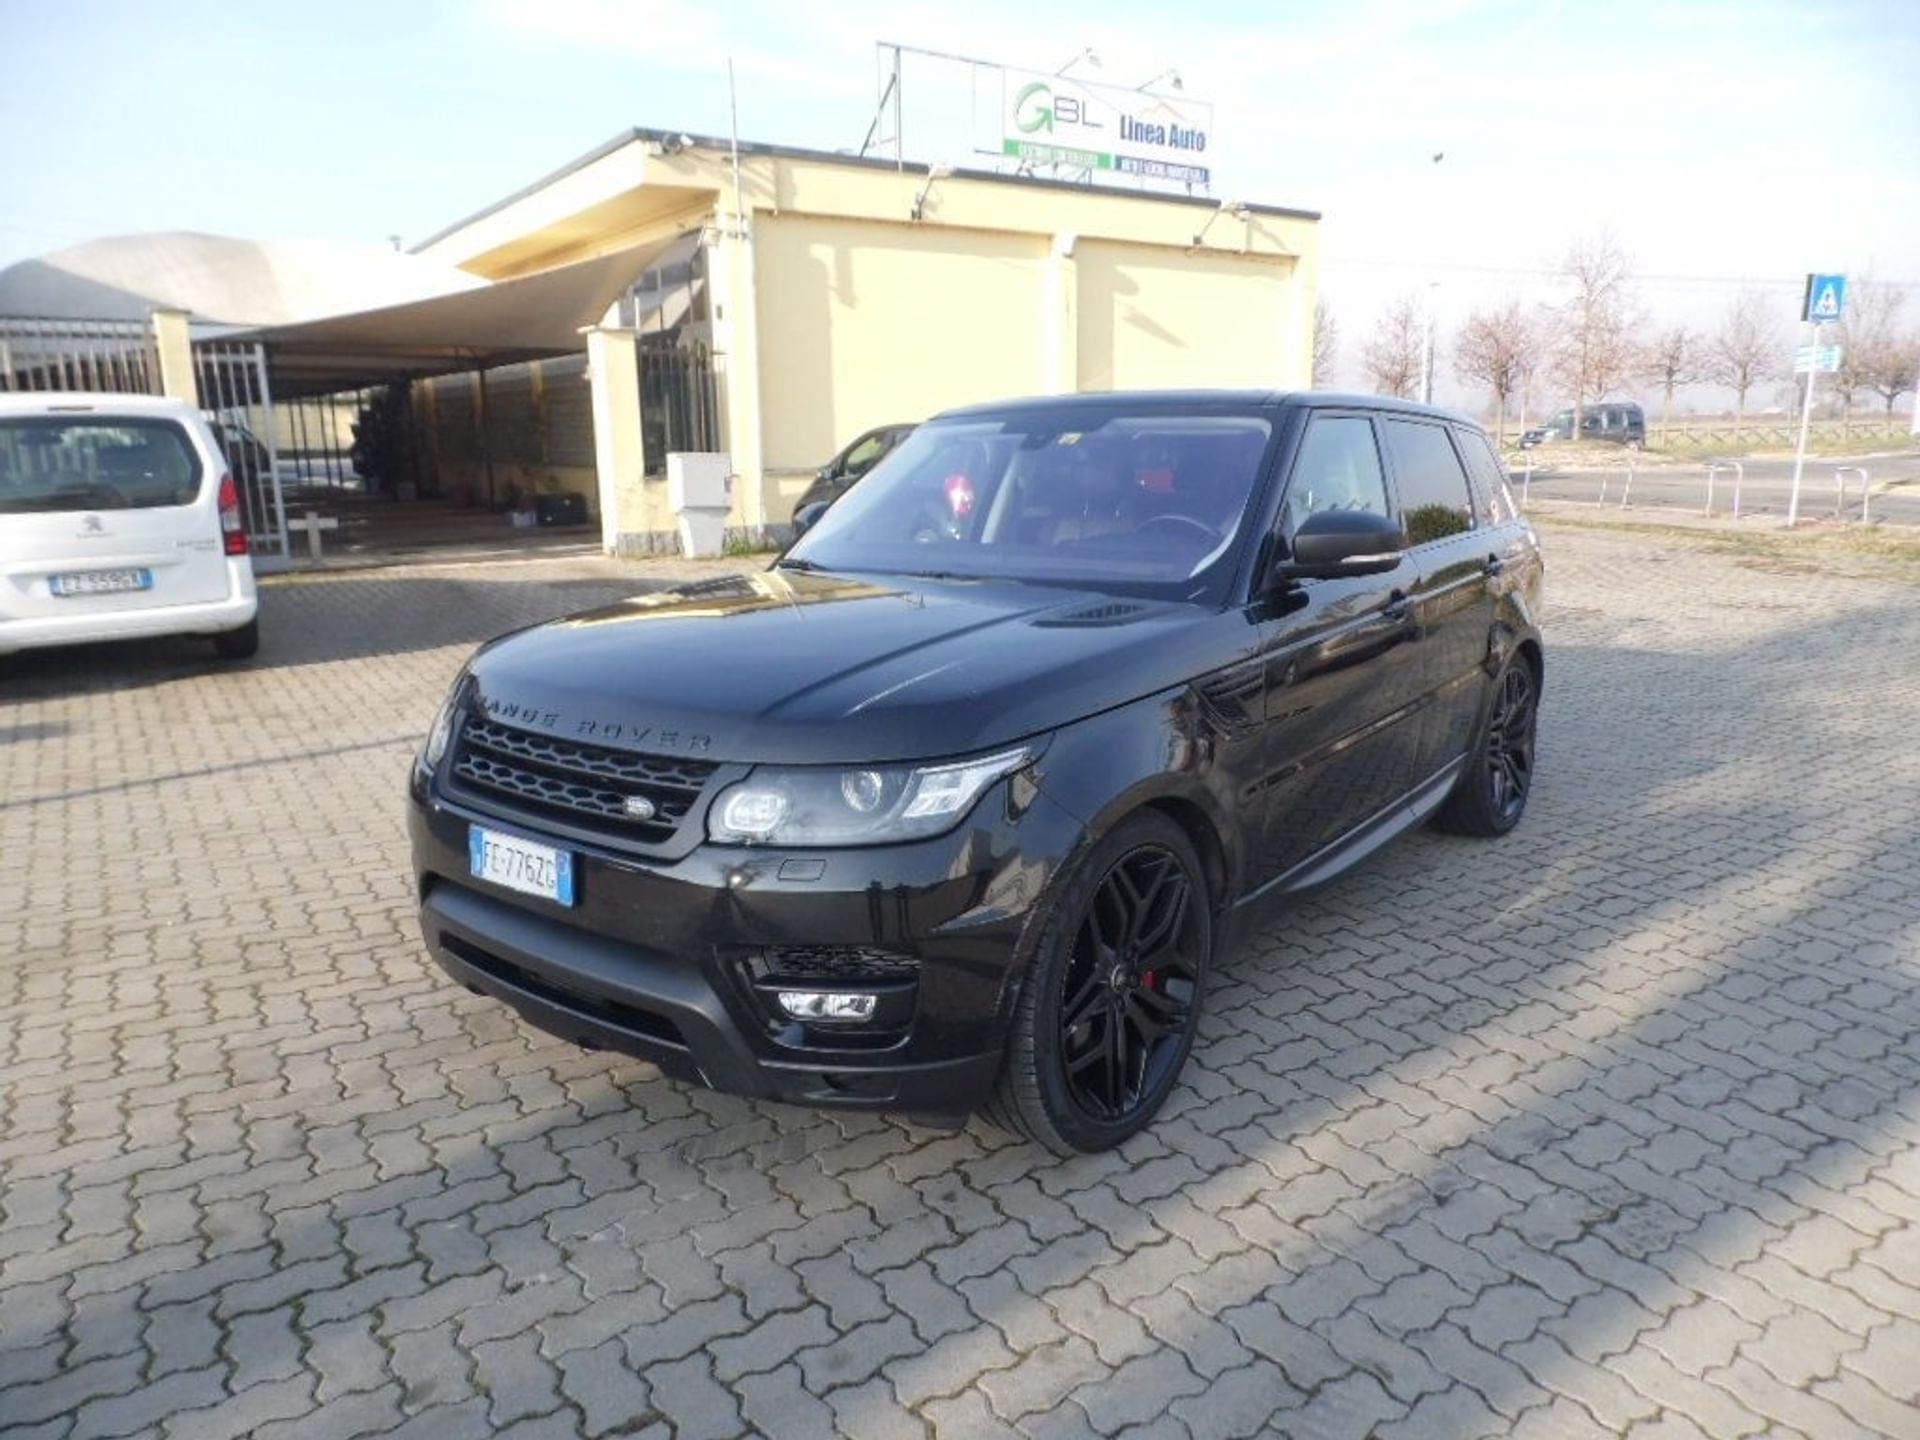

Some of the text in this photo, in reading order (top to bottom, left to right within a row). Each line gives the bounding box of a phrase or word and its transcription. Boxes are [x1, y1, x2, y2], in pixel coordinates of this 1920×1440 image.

[1120, 114, 1207, 152] Linea Auto
[482, 697, 712, 751] ANGE ROVER
